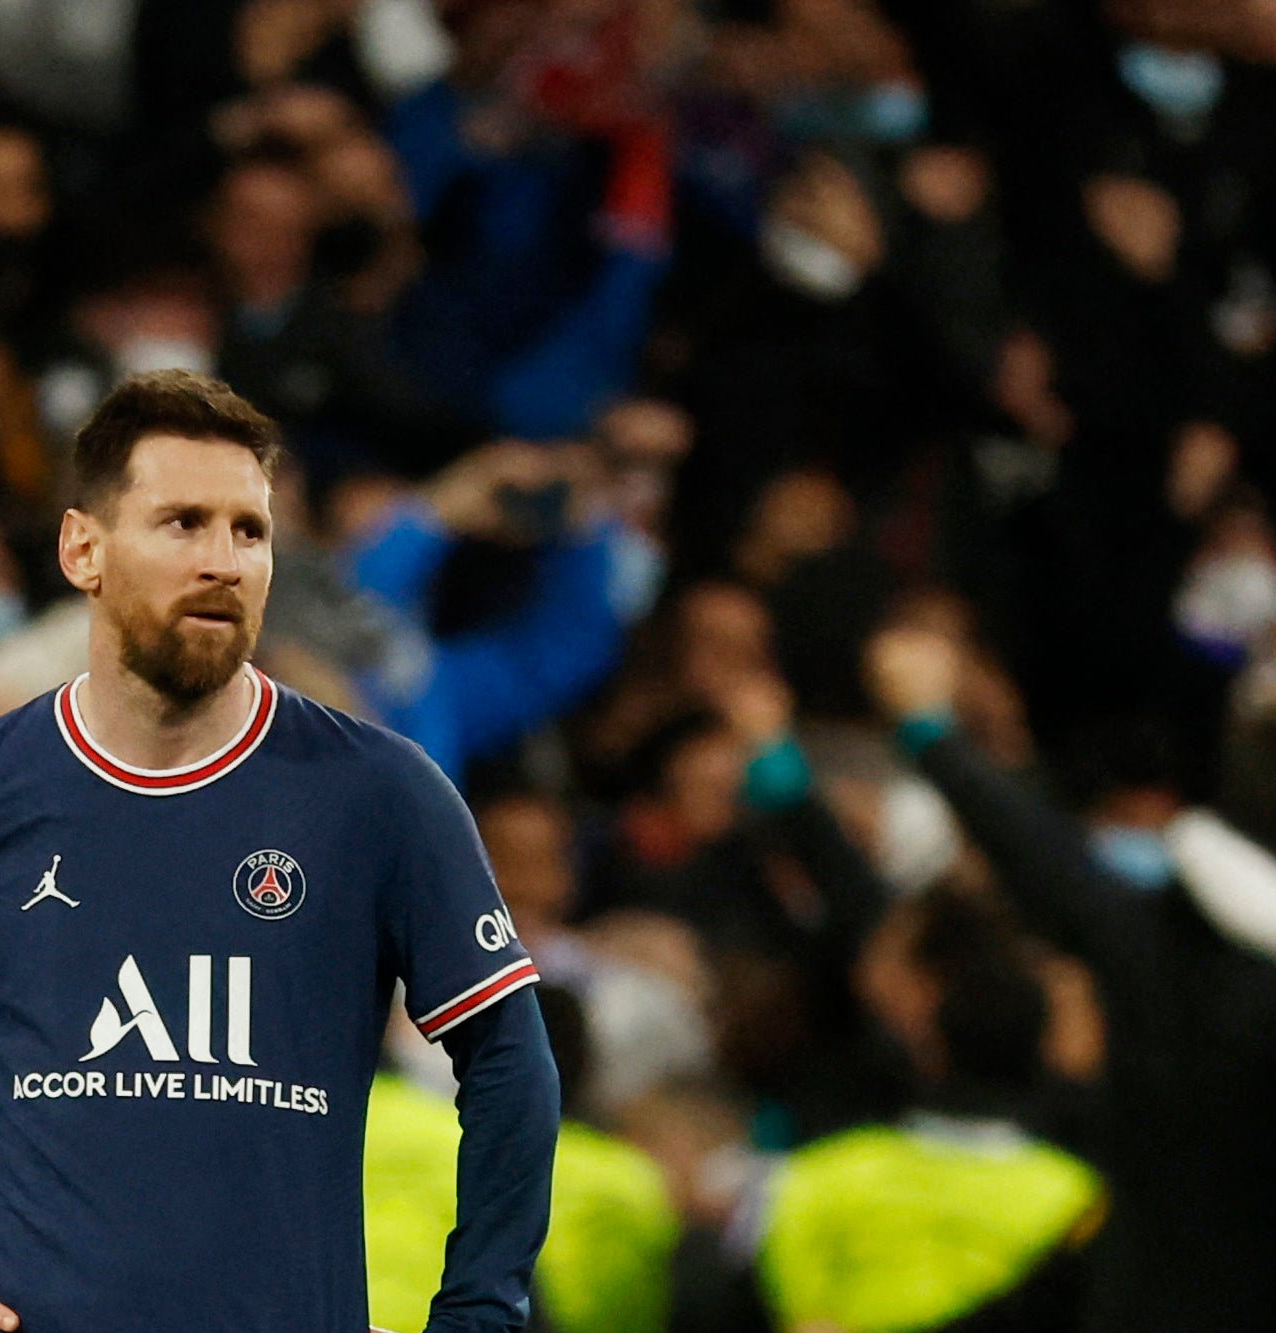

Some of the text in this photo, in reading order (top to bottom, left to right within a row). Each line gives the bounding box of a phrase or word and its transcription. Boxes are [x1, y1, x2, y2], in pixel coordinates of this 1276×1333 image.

[247, 853, 294, 873] PARIS
[13, 1071, 329, 1116] ACCOR LIVE LIMITLESS
